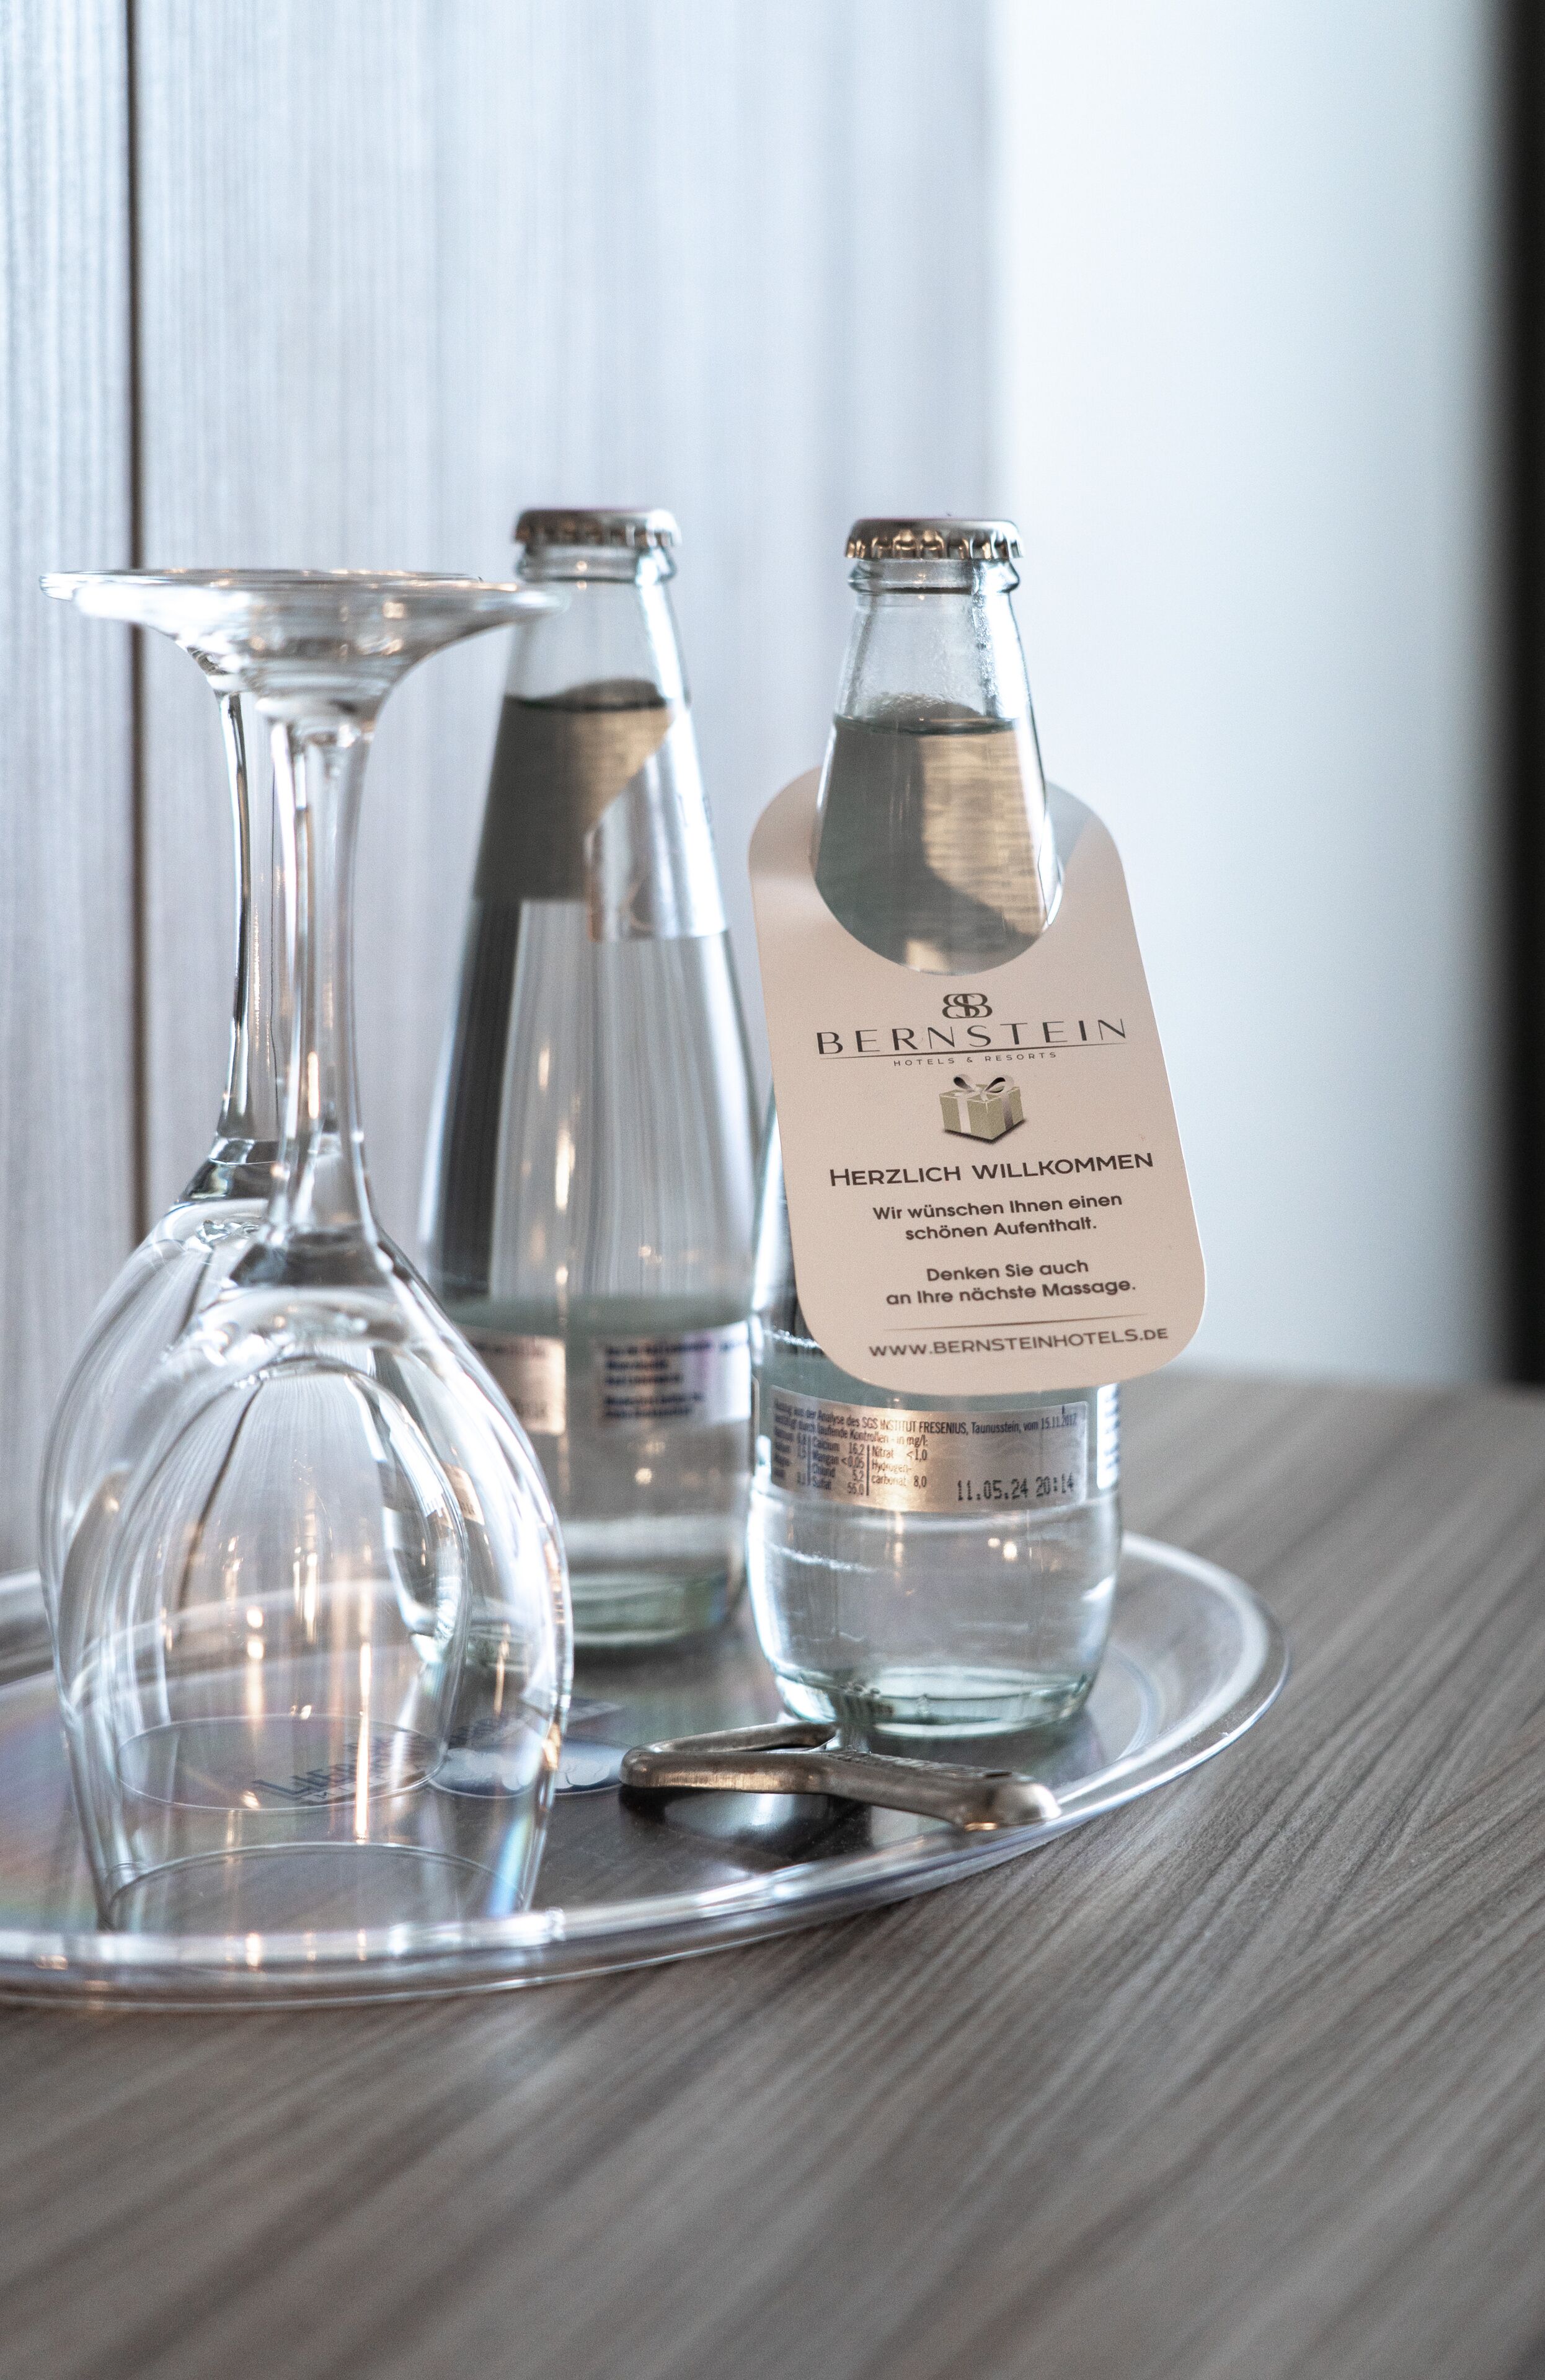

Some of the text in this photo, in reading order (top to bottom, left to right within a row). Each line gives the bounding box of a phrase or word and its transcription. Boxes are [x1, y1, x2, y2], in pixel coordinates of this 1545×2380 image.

[817, 1019, 1126, 1054] BERNSTEIN
[893, 1057, 955, 1067] HOTELS
[985, 1052, 1057, 1062] RESORTS
[830, 1153, 1153, 1186] HERZLICH WILLKOMMEN
[872, 1195, 1123, 1220] Wir wünschen Ihnen einen
[905, 1216, 1097, 1240] schönen Aufenthalt.
[926, 1259, 1089, 1282] Denken Sie auch
[886, 1280, 1136, 1305] an Ihre nächste Massage.
[817, 1409, 844, 1426] Analyse
[846, 1415, 861, 1427] des
[862, 1416, 879, 1430] SGS
[880, 1418, 917, 1433] INSTITUT
[919, 1421, 968, 1436] FRESENIUS,
[972, 1421, 1022, 1434] Taunusstein,
[1023, 1420, 1038, 1432] vom
[849, 1428, 889, 1443] Kontrollen
[897, 1434, 905, 1445] in
[872, 1445, 894, 1459] Nitrat
[913, 1474, 927, 1489] 8,0
[958, 1473, 1074, 1501] 11.05.24 20:14
